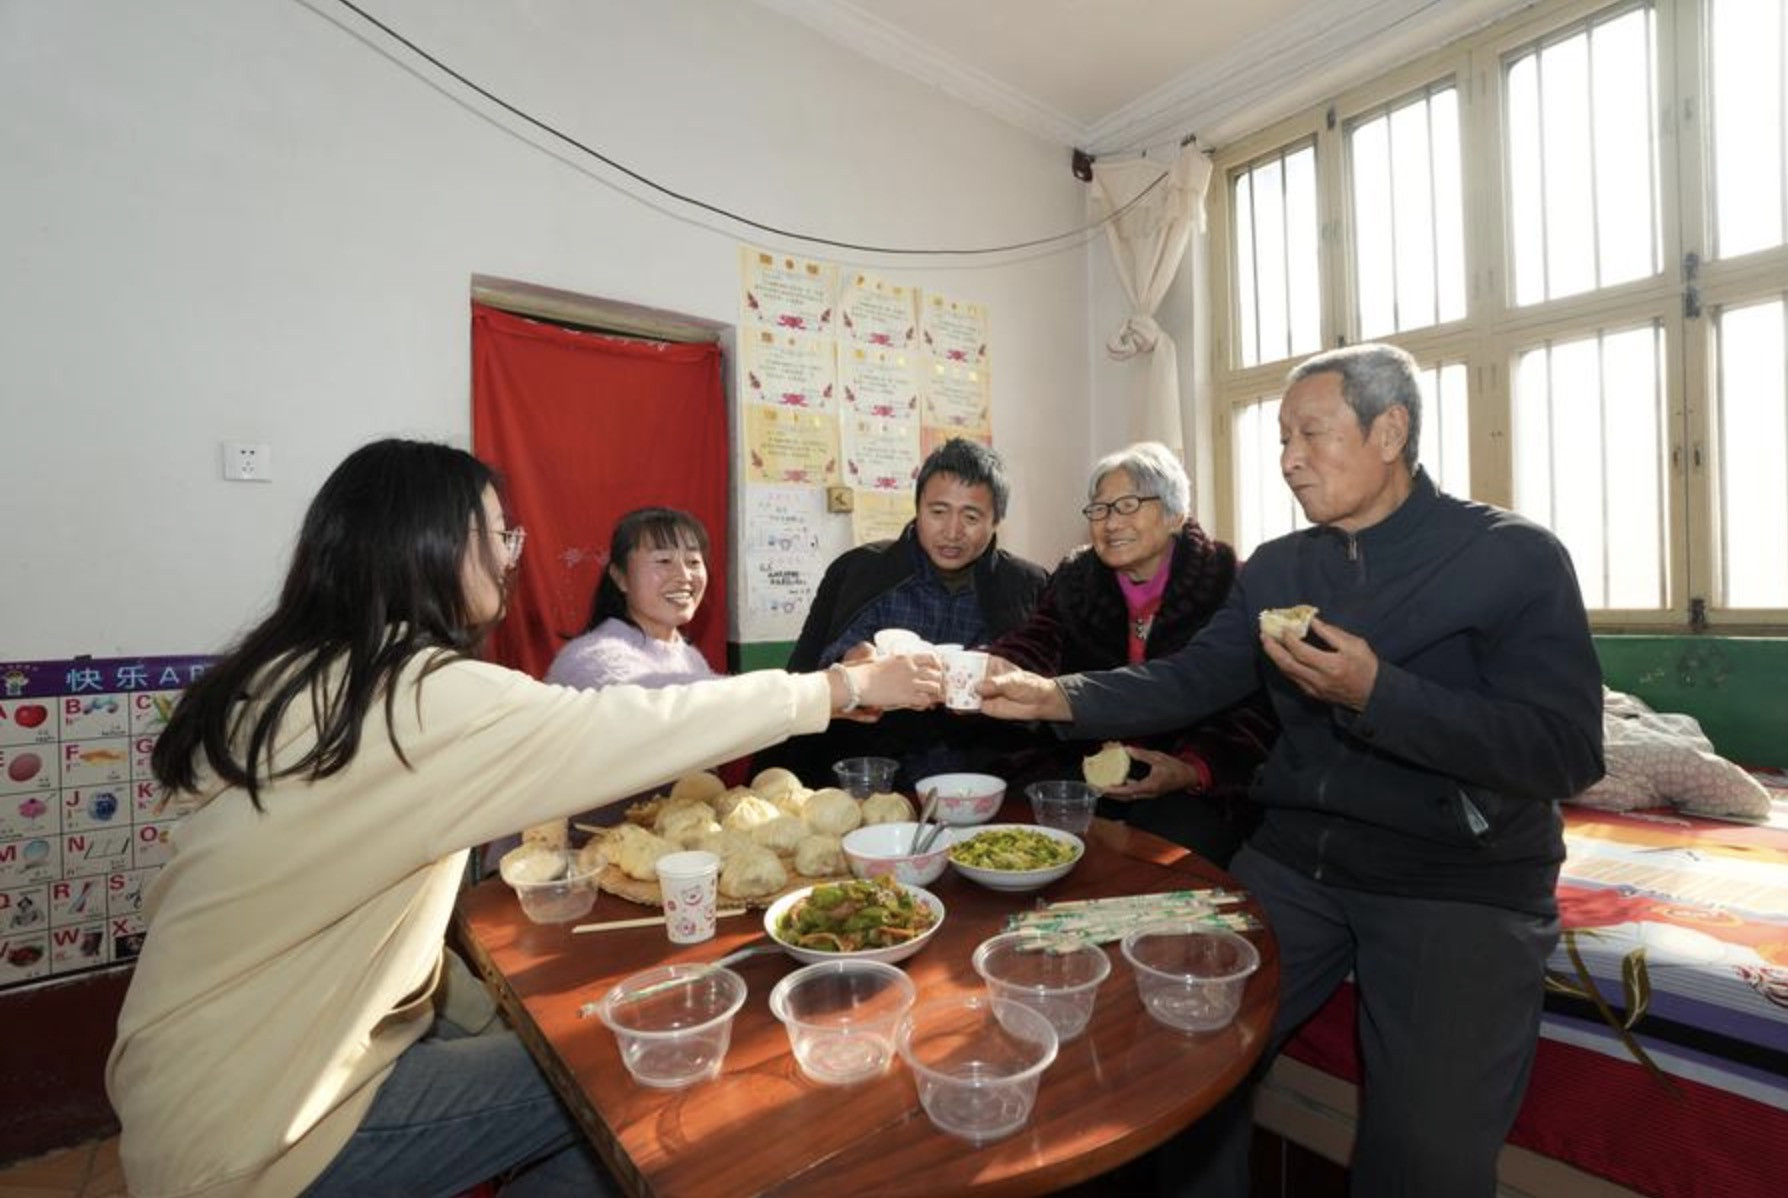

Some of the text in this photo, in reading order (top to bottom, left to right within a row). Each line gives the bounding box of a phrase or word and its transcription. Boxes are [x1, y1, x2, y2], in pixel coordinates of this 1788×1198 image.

[65, 698, 81, 715] B
[135, 694, 152, 710] C
[65, 744, 80, 760] F
[135, 738, 153, 754] G
[65, 790, 80, 807] J
[137, 782, 153, 798] K
[140, 825, 158, 842] O
[67, 835, 85, 853] N
[109, 874, 125, 890] S
[53, 882, 70, 900] R
[112, 918, 129, 937] X
[53, 927, 80, 947] W
